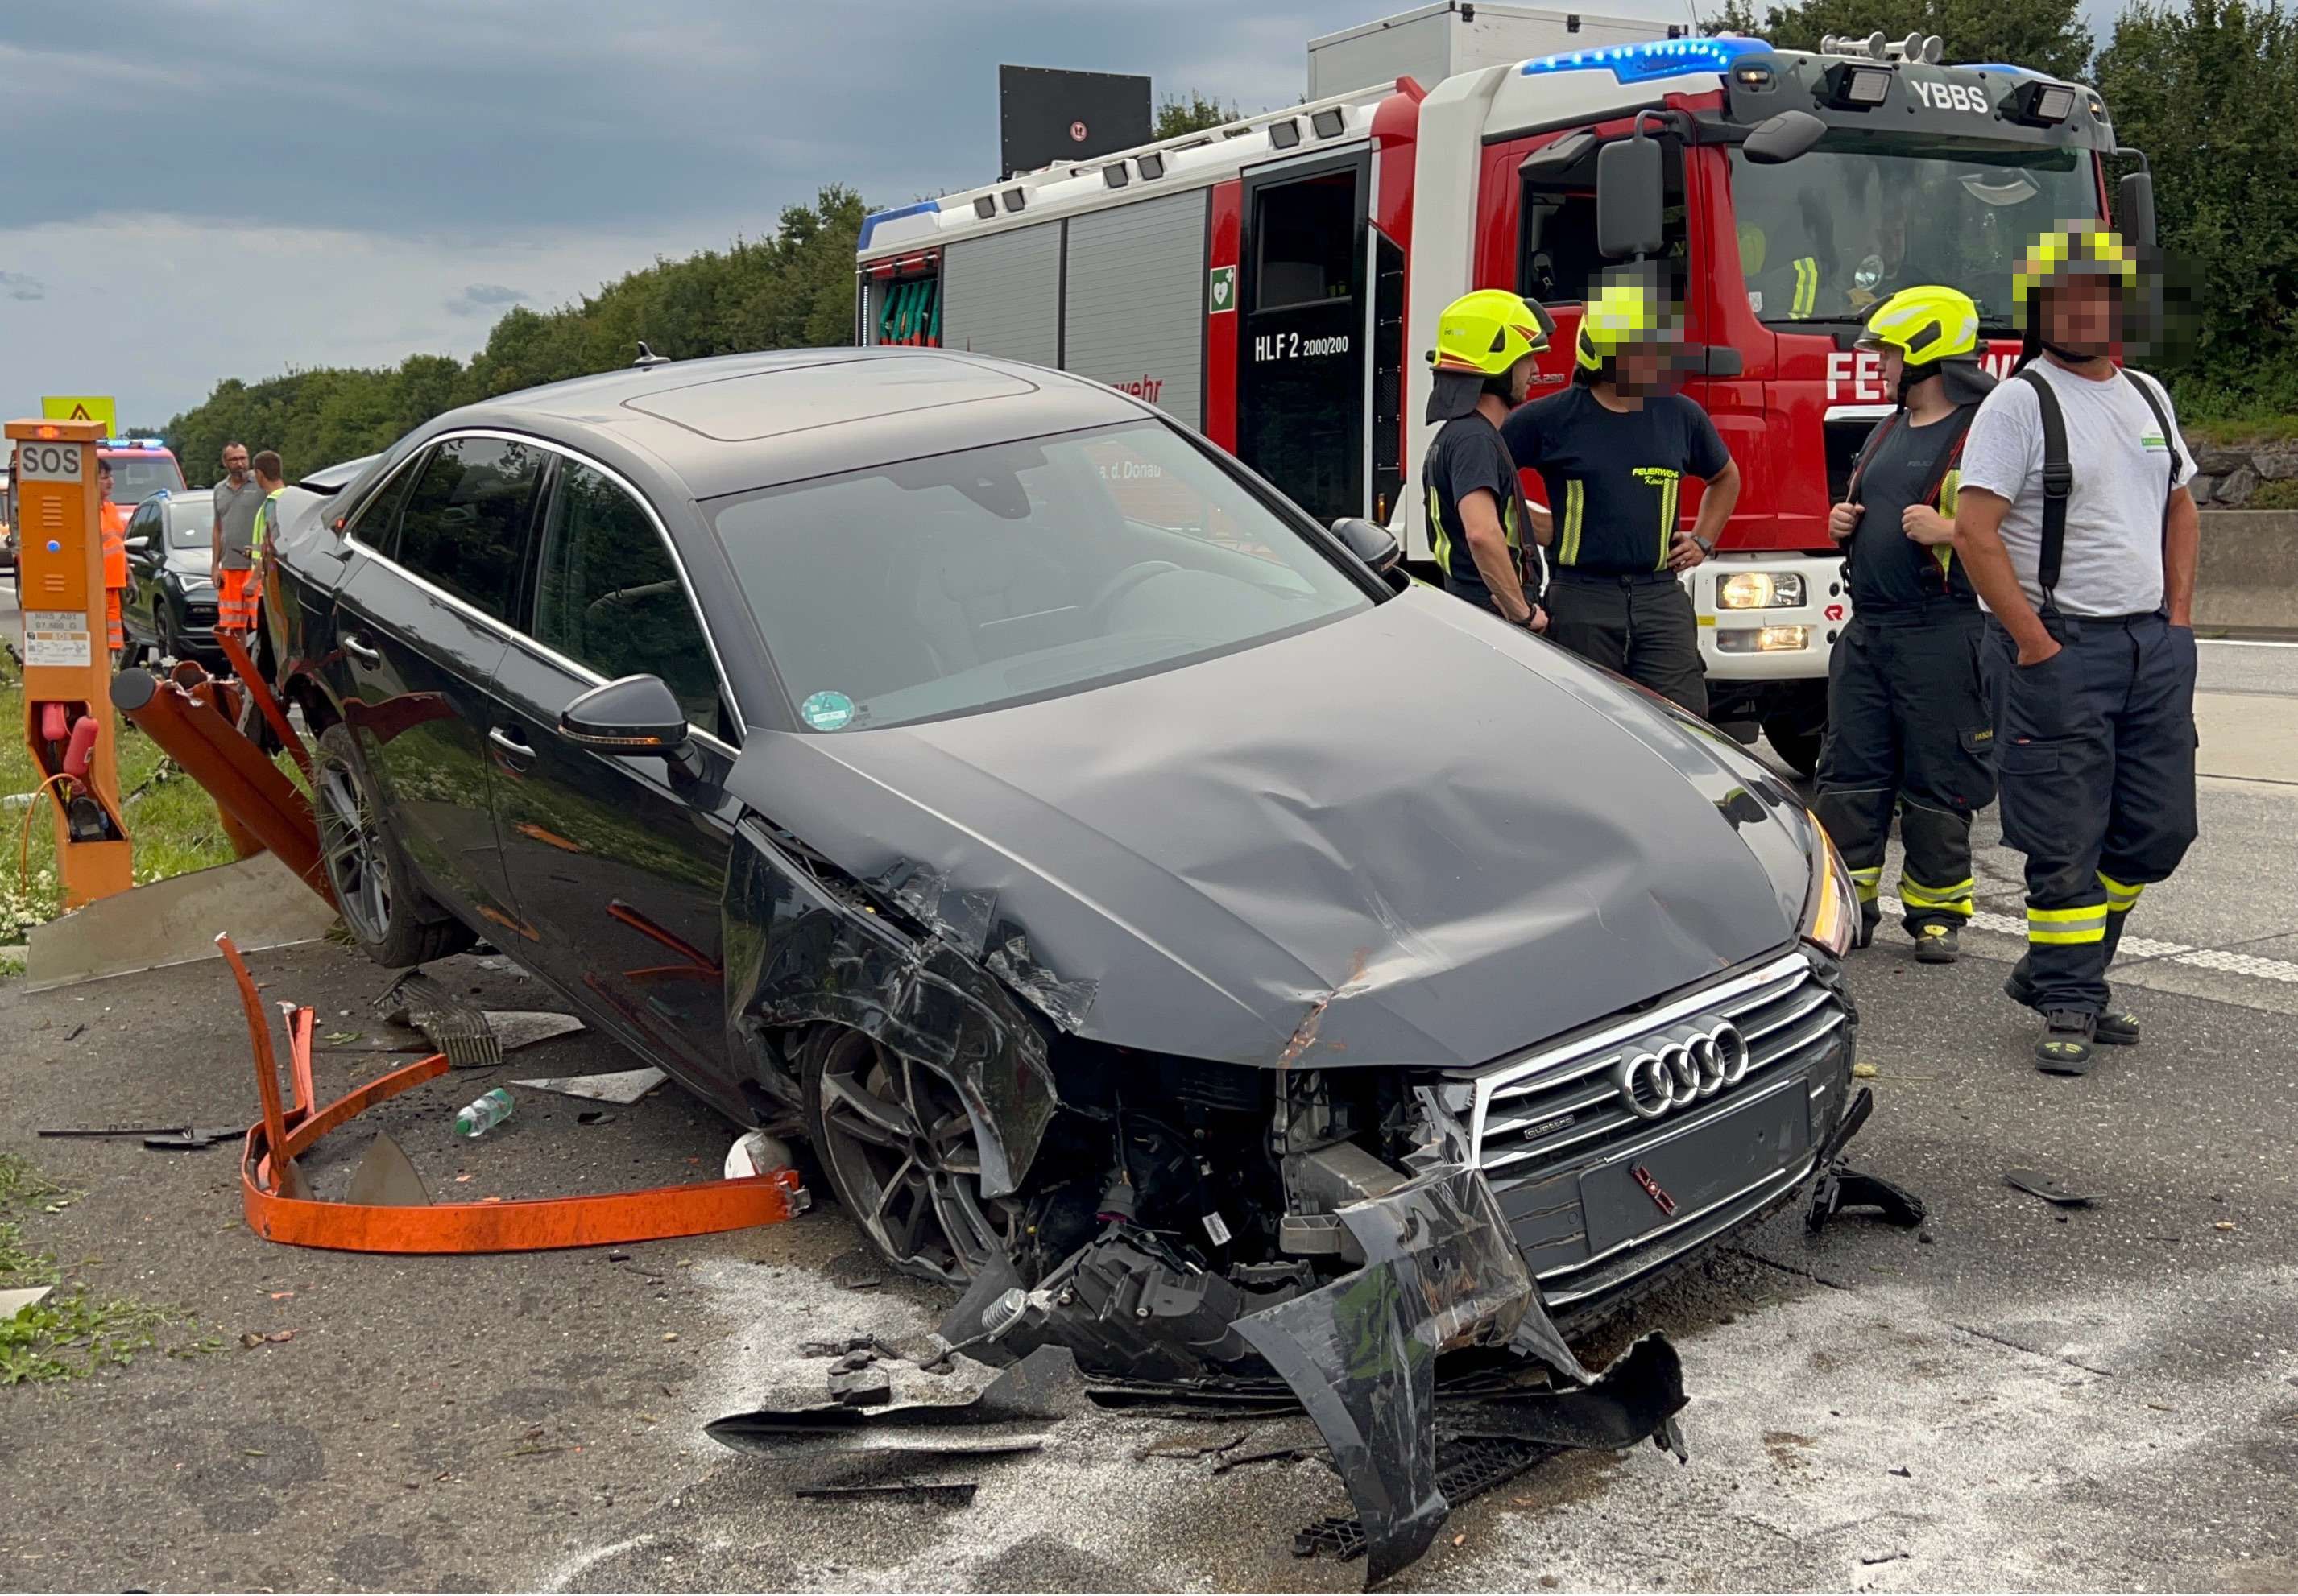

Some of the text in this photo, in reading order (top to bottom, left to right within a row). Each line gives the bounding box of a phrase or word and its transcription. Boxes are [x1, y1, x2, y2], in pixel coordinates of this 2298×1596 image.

[1911, 80, 1988, 113] YBBS
[1255, 332, 1349, 362] HLF 2 2000/200
[23, 446, 79, 473] SOS
[1124, 461, 1161, 479] Donau
